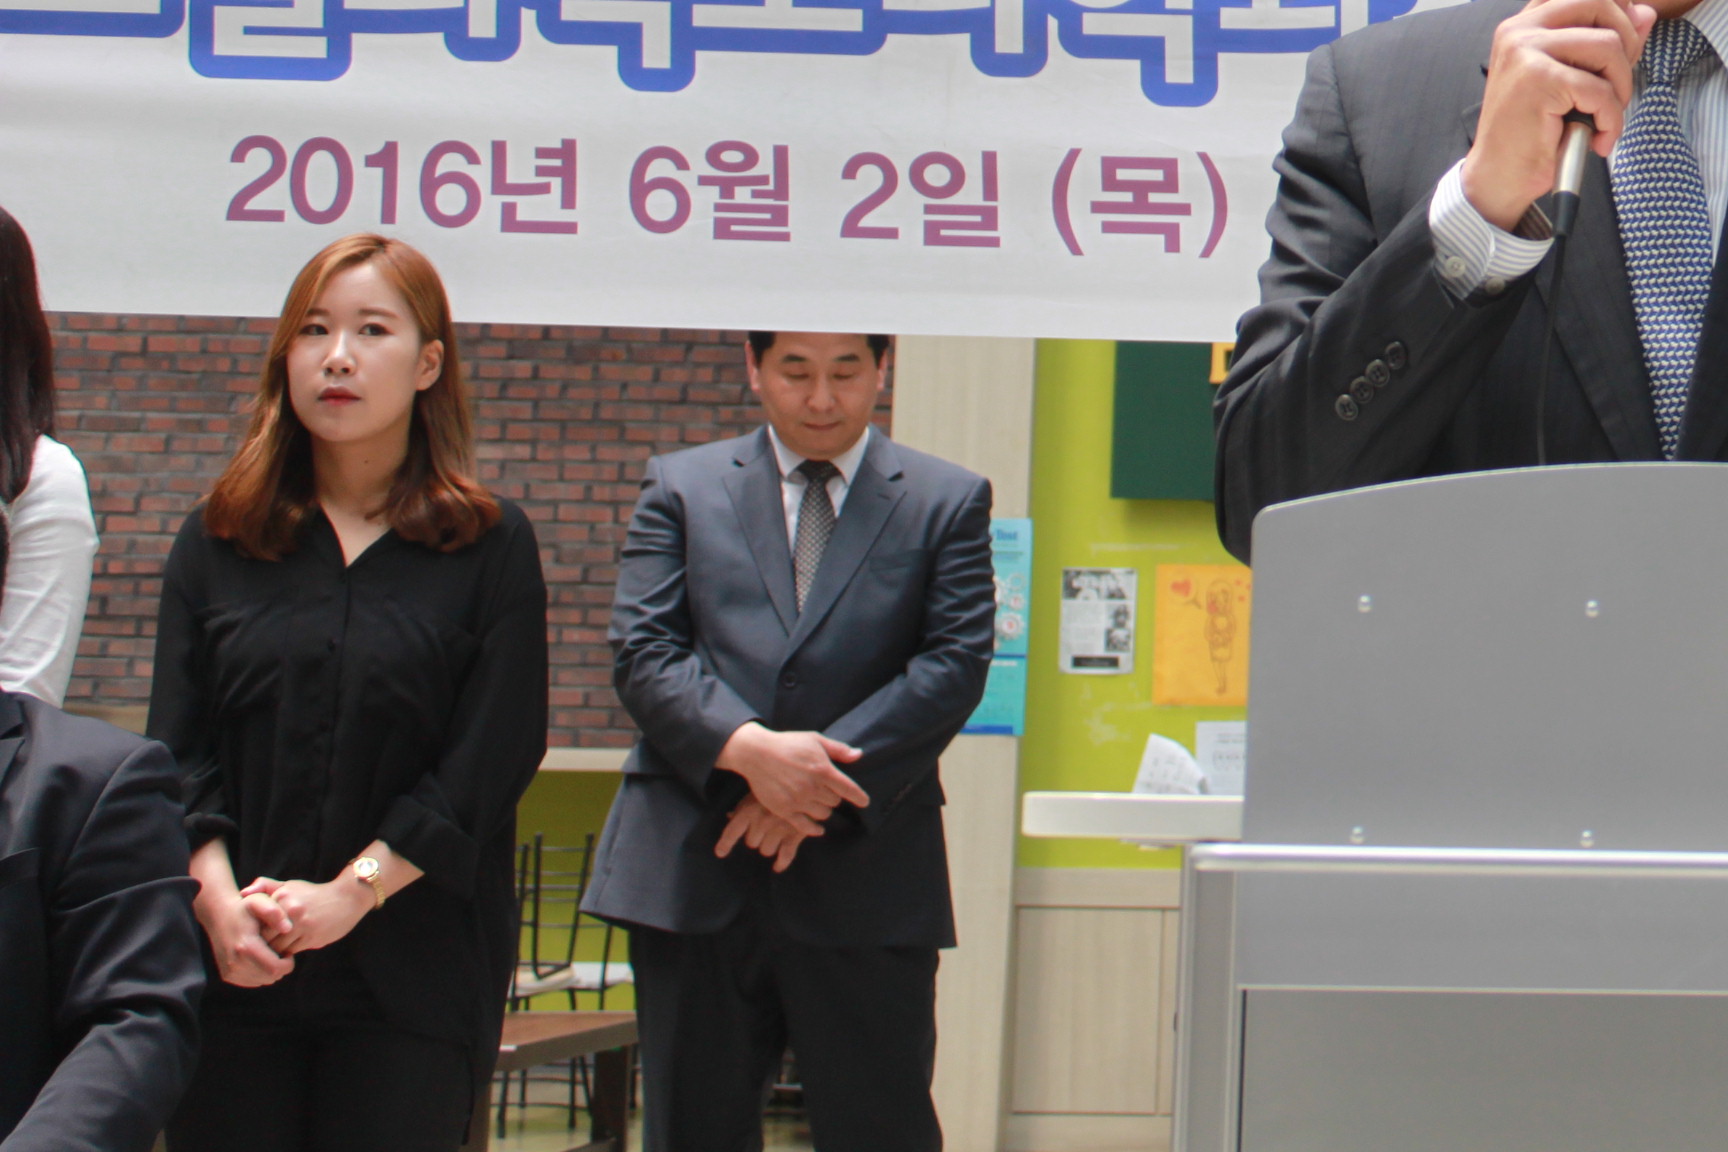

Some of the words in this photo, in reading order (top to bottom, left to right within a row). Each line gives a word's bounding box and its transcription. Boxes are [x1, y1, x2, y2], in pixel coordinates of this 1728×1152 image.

[225, 134, 580, 235] 2016년
[629, 140, 792, 242] 6월
[840, 150, 1001, 248] 2일
[1051, 147, 1229, 259] (목)
